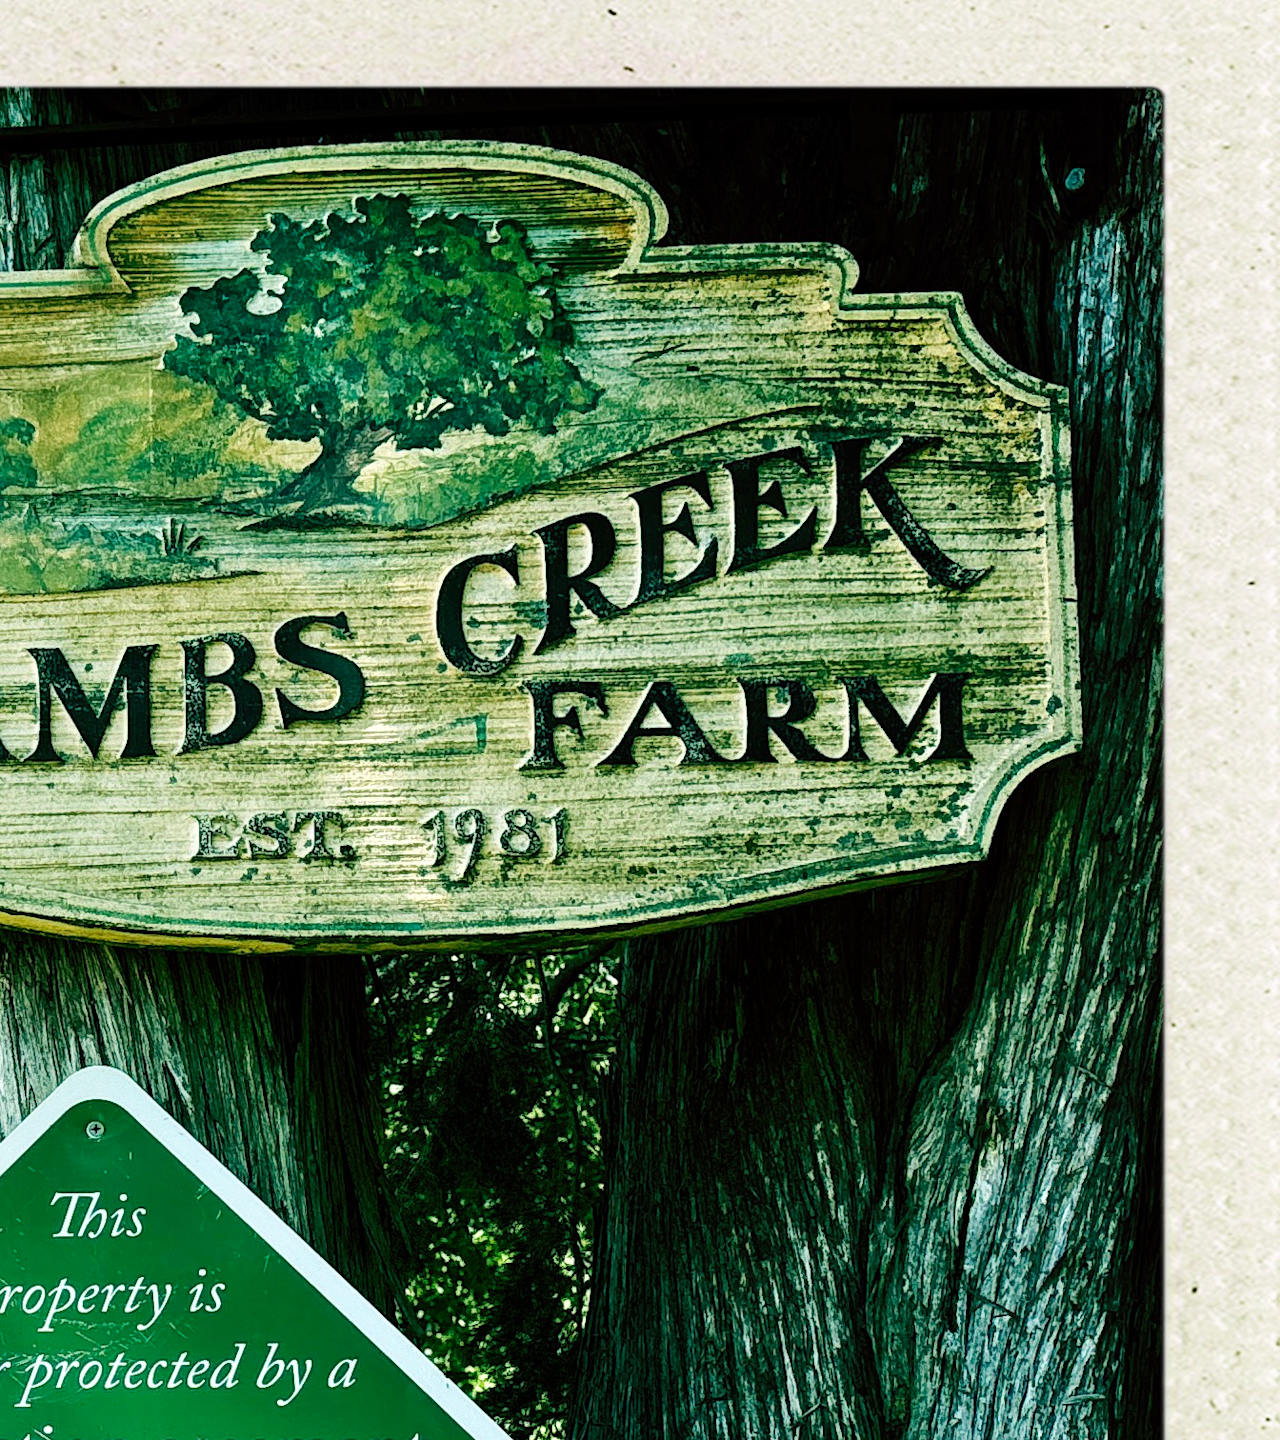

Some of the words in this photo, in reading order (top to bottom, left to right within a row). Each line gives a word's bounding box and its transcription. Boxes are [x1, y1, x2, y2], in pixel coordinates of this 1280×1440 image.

[437, 434, 994, 677] CREEK
[519, 671, 971, 772] FARM
[192, 812, 357, 864] EST.
[421, 807, 568, 886] 1981
[49, 1191, 148, 1239] This
[188, 1268, 226, 1314] is
[13, 1343, 247, 1408] protected
[256, 1342, 315, 1407] by
[327, 1353, 357, 1390] a
